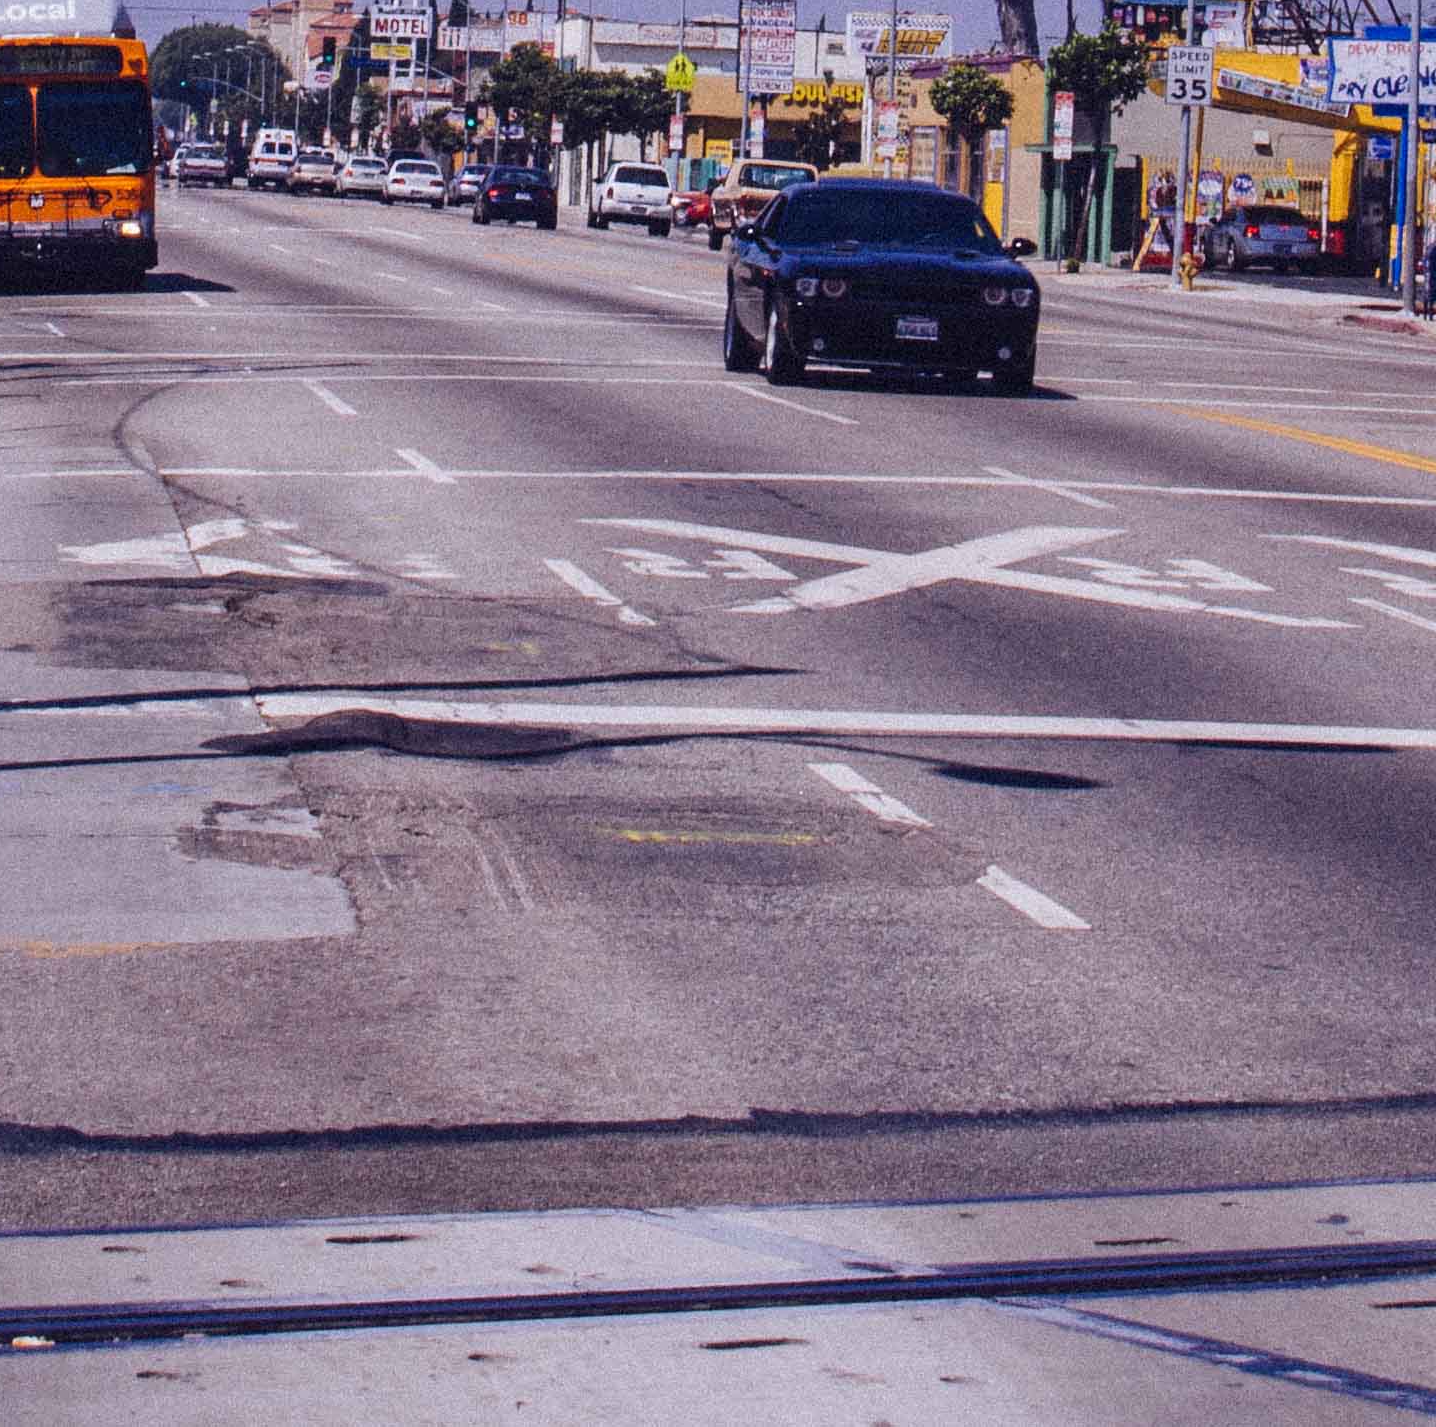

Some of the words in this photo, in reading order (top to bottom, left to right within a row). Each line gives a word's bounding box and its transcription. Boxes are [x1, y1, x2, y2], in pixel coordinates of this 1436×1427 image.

[375, 18, 427, 35] MOTEL
[1171, 52, 1210, 62] SPEED
[1174, 65, 1205, 75] LIMIT
[1171, 78, 1207, 101] 35
